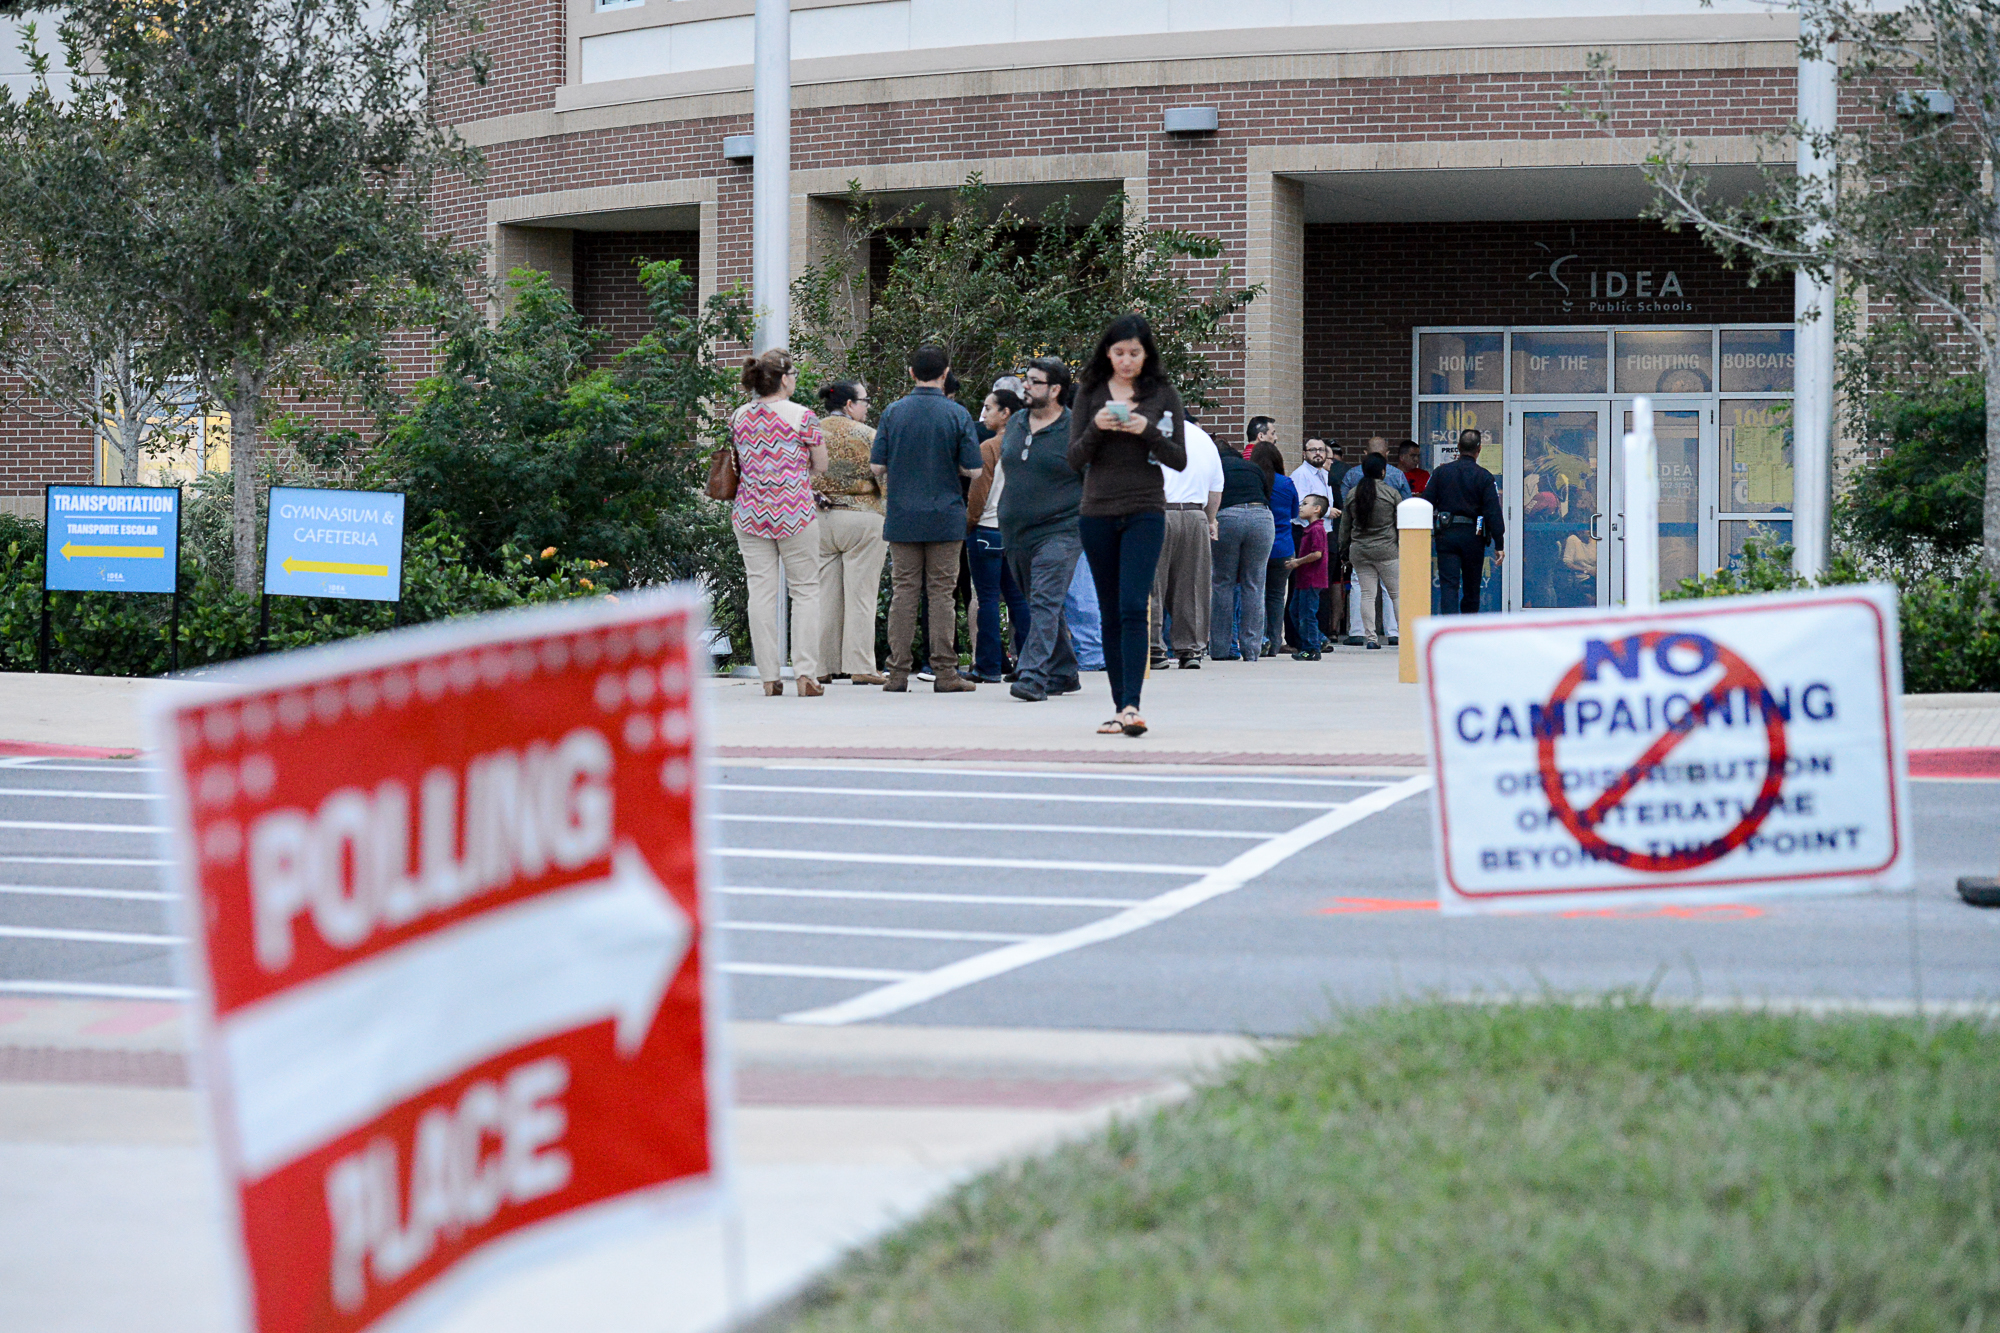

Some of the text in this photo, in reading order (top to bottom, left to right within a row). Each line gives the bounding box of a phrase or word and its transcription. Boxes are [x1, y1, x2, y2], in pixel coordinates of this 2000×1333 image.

[1590, 270, 1684, 298] IDEA
[1589, 300, 1693, 312] Public Schools
[1438, 352, 1796, 371] HOME OF THE FIGHTING BOBCATS
[1446, 410, 1477, 430] NO
[1661, 464, 1693, 477] DEA
[53, 494, 174, 512] TRANSPORTATION
[280, 504, 395, 525] GYMNASIUM &
[67, 524, 158, 535] TRANSPORTE ESCOLAR
[293, 527, 379, 546] CAFETERIA
[1583, 633, 1717, 681] NO
[1455, 684, 1835, 743] CAMPAIGNING
[249, 727, 615, 971] POLLING
[1480, 843, 1629, 870] BEYOND
[1745, 826, 1859, 855] POINT
[325, 1053, 571, 1313] PLACE
